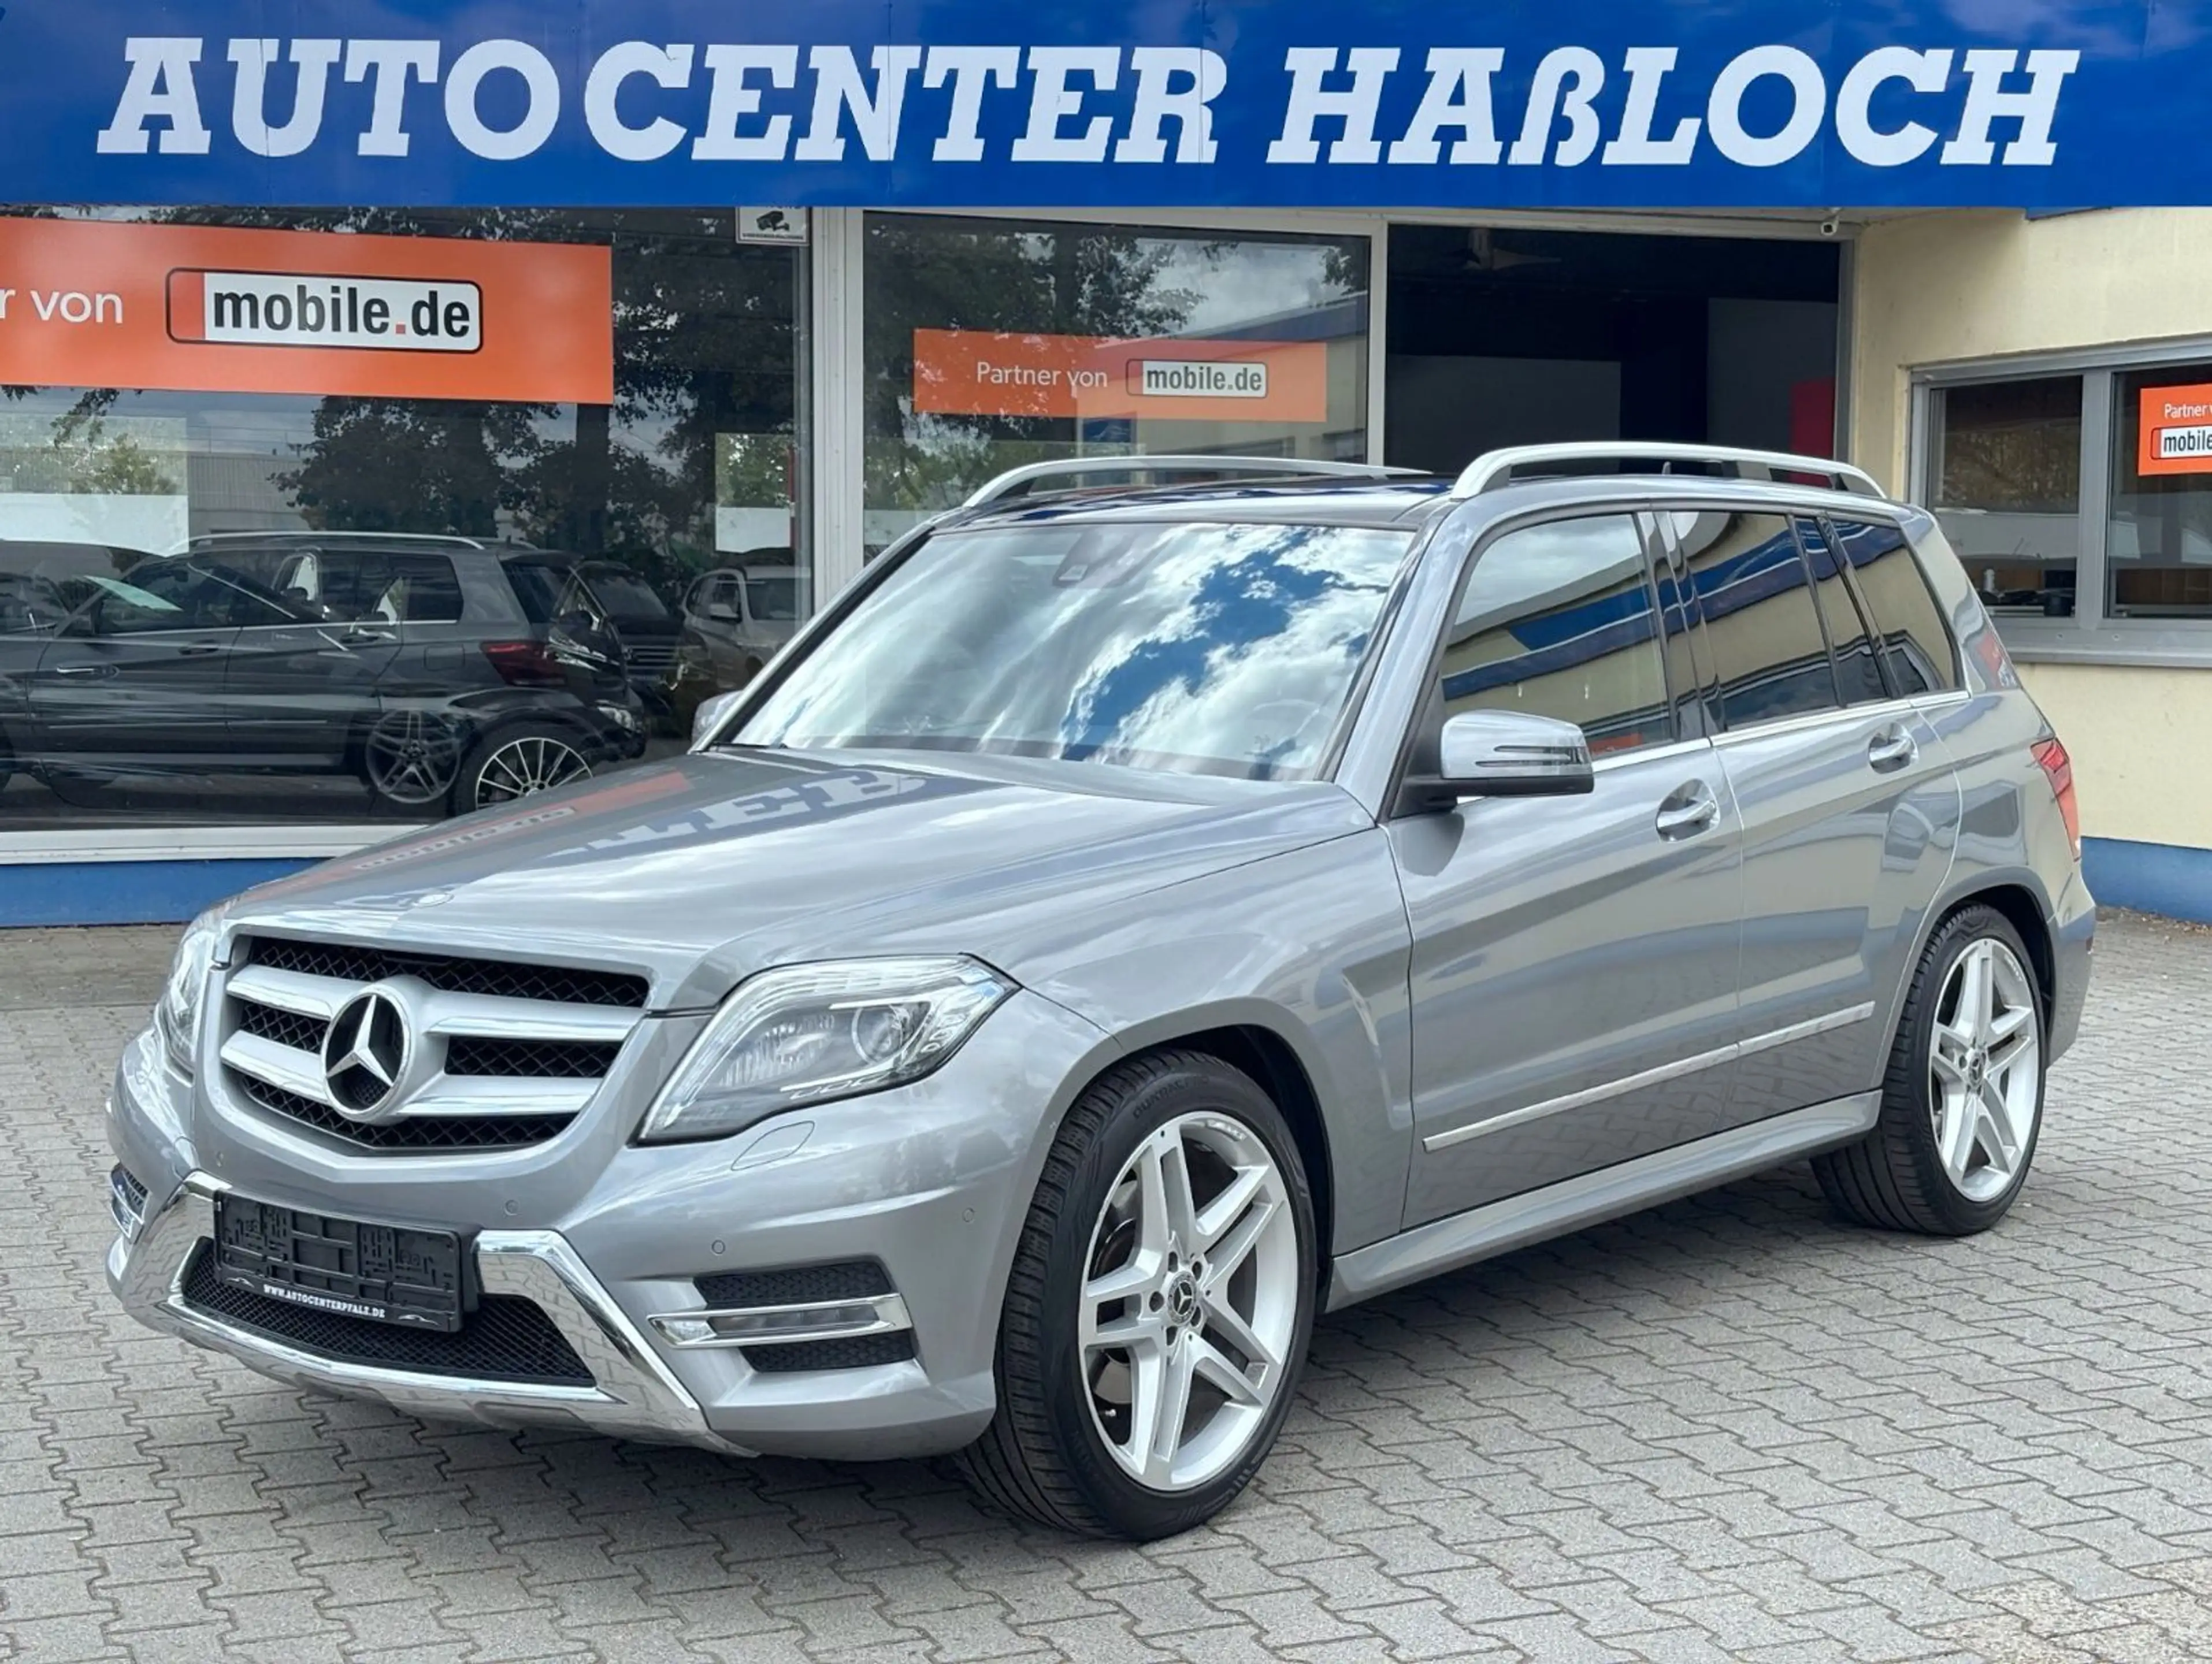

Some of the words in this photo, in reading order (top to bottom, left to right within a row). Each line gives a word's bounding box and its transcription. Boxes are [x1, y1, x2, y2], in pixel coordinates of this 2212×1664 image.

[1266, 44, 2081, 167] HAßLOCH
[30, 289, 123, 324] von
[214, 284, 470, 338] mobile.de
[977, 361, 1062, 386] Partner
[1066, 370, 1108, 388] von
[1146, 366, 1262, 391] mobile.de
[2165, 403, 2206, 419] Partner
[263, 1283, 385, 1318] WWW.AUTOCENTERPFALZ.DE
